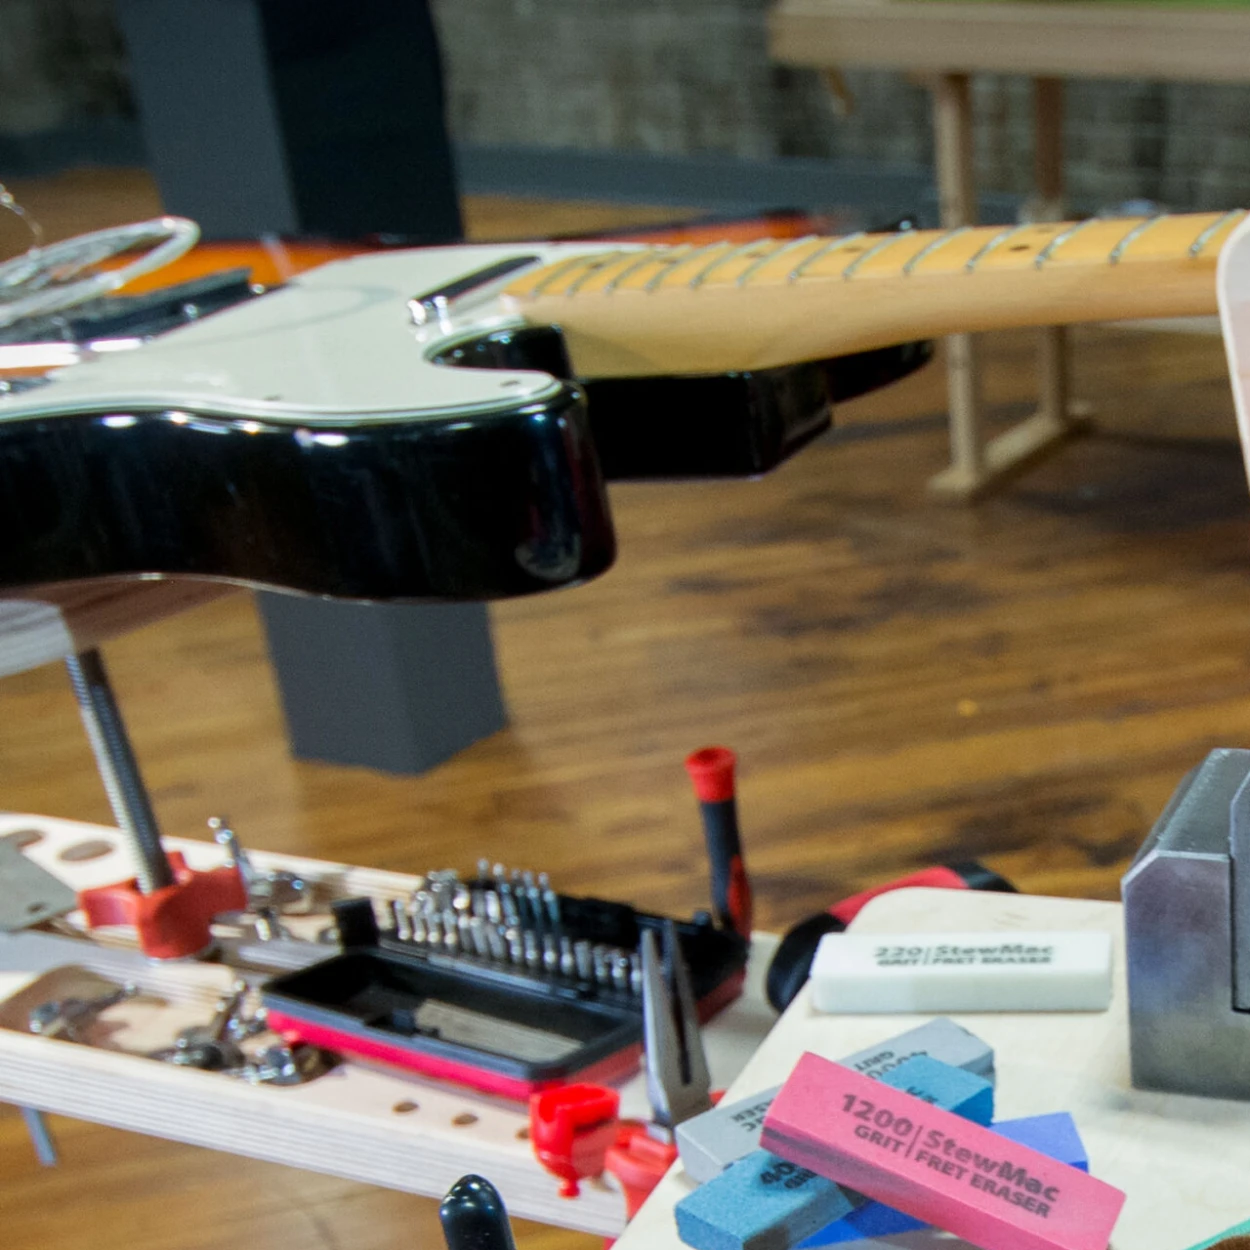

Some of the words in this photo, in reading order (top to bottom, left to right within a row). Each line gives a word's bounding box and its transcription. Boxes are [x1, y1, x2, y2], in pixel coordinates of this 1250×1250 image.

[933, 957, 975, 966] FRET
[981, 956, 1051, 965] ERASER
[935, 943, 1053, 956] StewMac
[842, 1093, 914, 1137] 1200
[923, 1129, 1061, 1202] StewMac
[854, 1125, 905, 1152] GRIT
[914, 1150, 969, 1181] FRET
[969, 1172, 1051, 1218] ERASER
